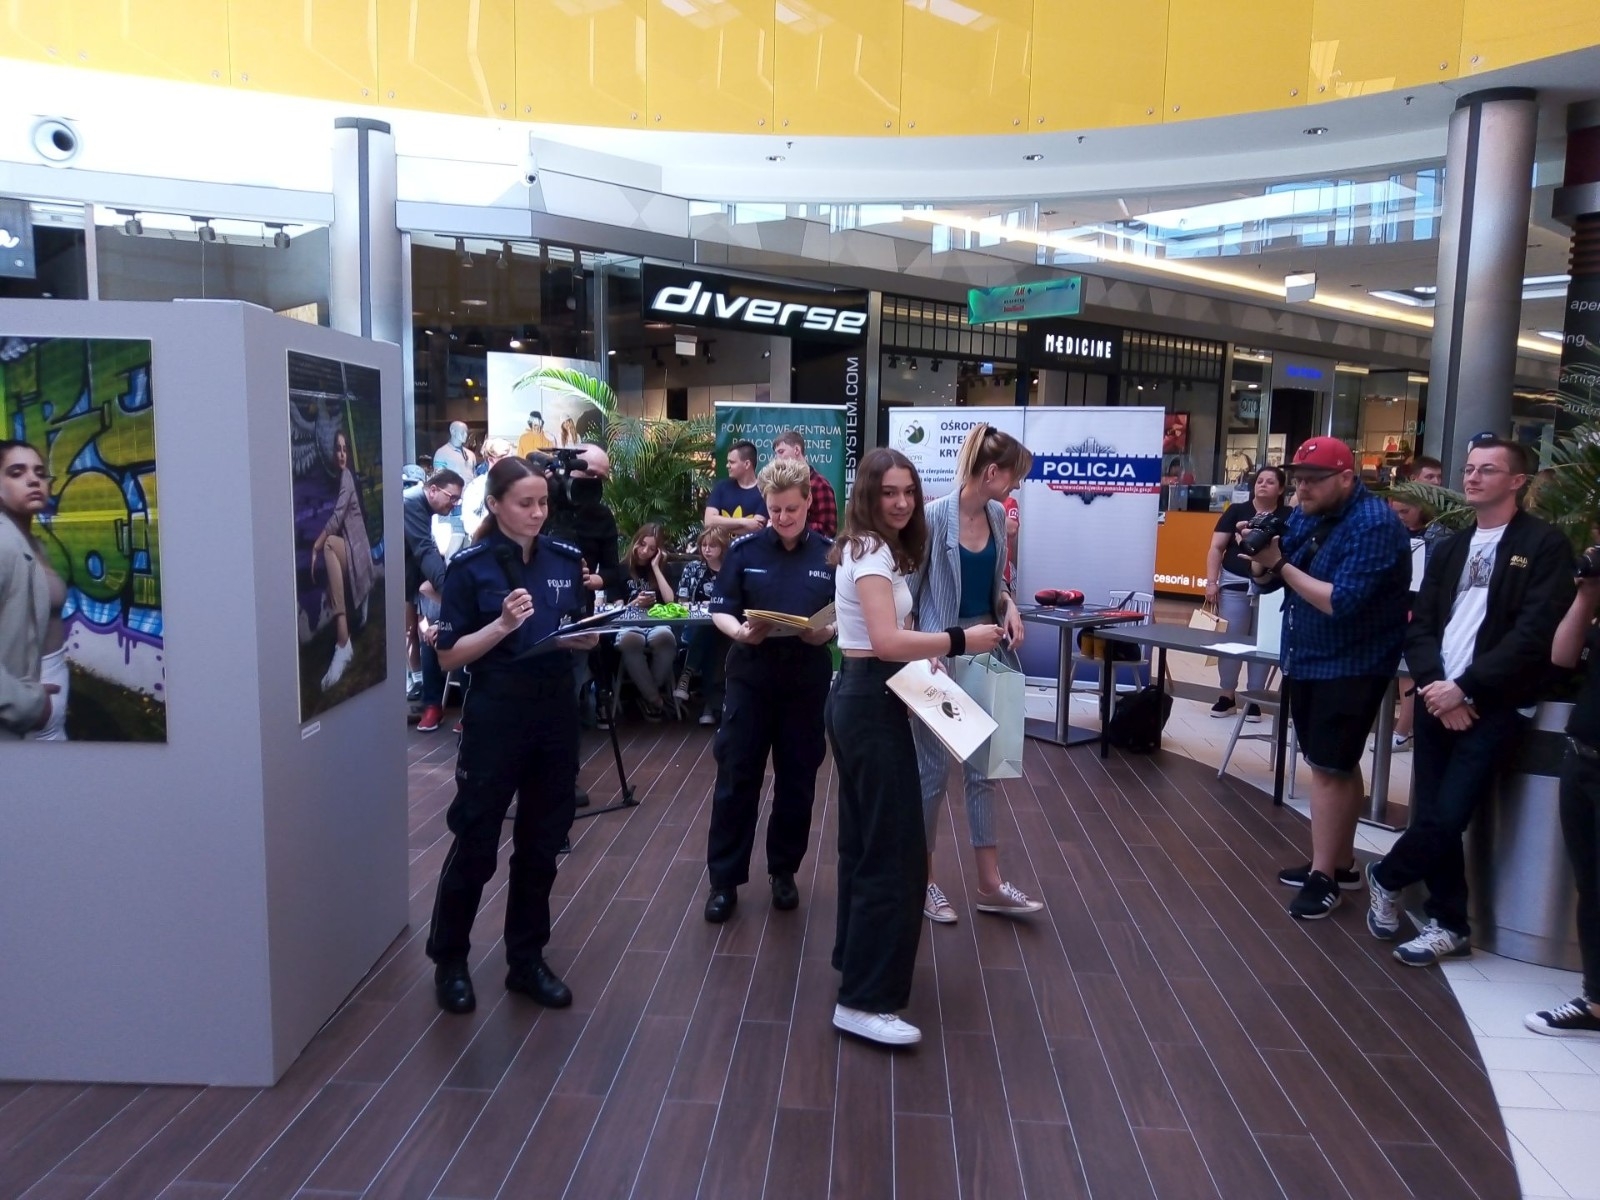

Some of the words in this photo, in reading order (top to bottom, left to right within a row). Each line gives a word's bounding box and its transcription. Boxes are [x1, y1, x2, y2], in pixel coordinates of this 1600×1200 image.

[651, 281, 867, 334] diverse
[1045, 333, 1112, 359] MEDICINE
[721, 423, 790, 434] POWIATOWE
[793, 424, 841, 435] CENTRUM
[845, 357, 858, 505] SESYSTEM.COM
[940, 420, 989, 431] OŚROD
[940, 435, 967, 445] INTE
[1043, 461, 1136, 478] POLICJA
